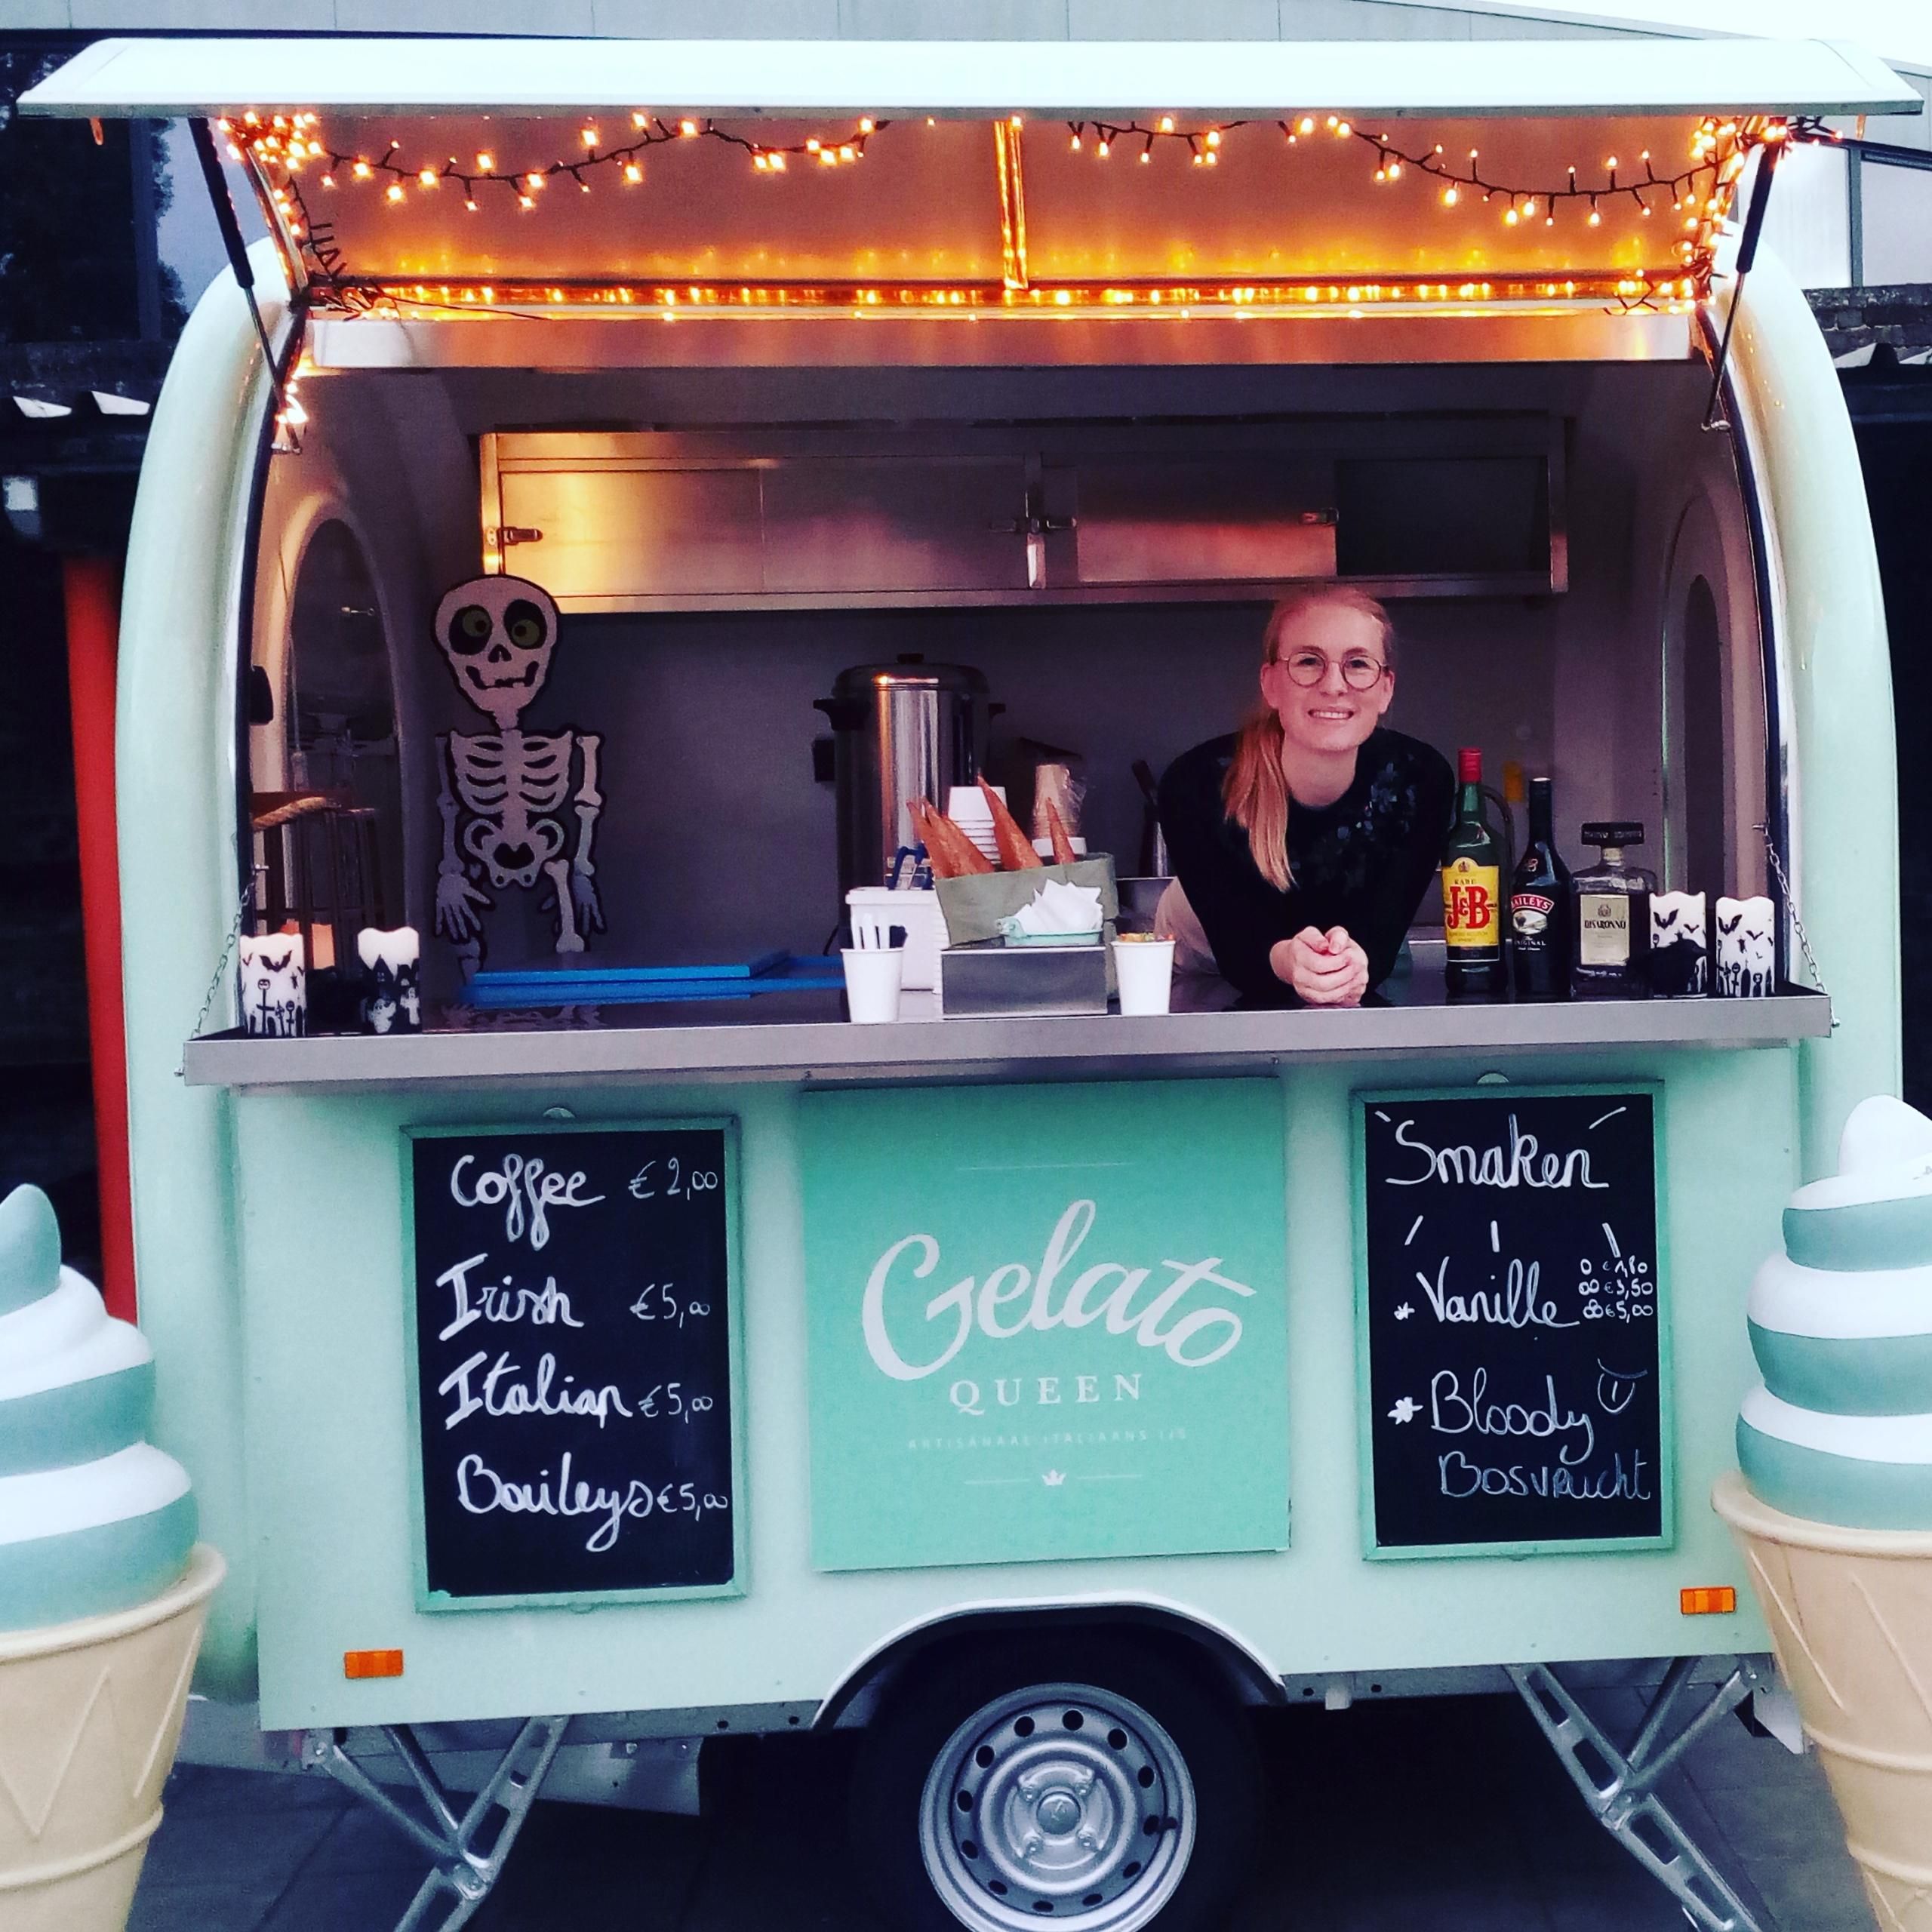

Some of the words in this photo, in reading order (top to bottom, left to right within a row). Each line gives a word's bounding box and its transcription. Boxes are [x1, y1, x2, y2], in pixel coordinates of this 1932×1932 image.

[1446, 885, 1491, 930] J&B
[1385, 1113, 1610, 1189] Smaken
[450, 1153, 606, 1251] Coffee
[435, 1252, 585, 1342] Irish
[862, 1198, 1257, 1381] Gelato
[1415, 1256, 1581, 1329] Vanille
[438, 1350, 634, 1431] Italian
[949, 1373, 1143, 1417] QUEEN
[1430, 1367, 1595, 1466] Bloody
[457, 1451, 654, 1552] Baileys
